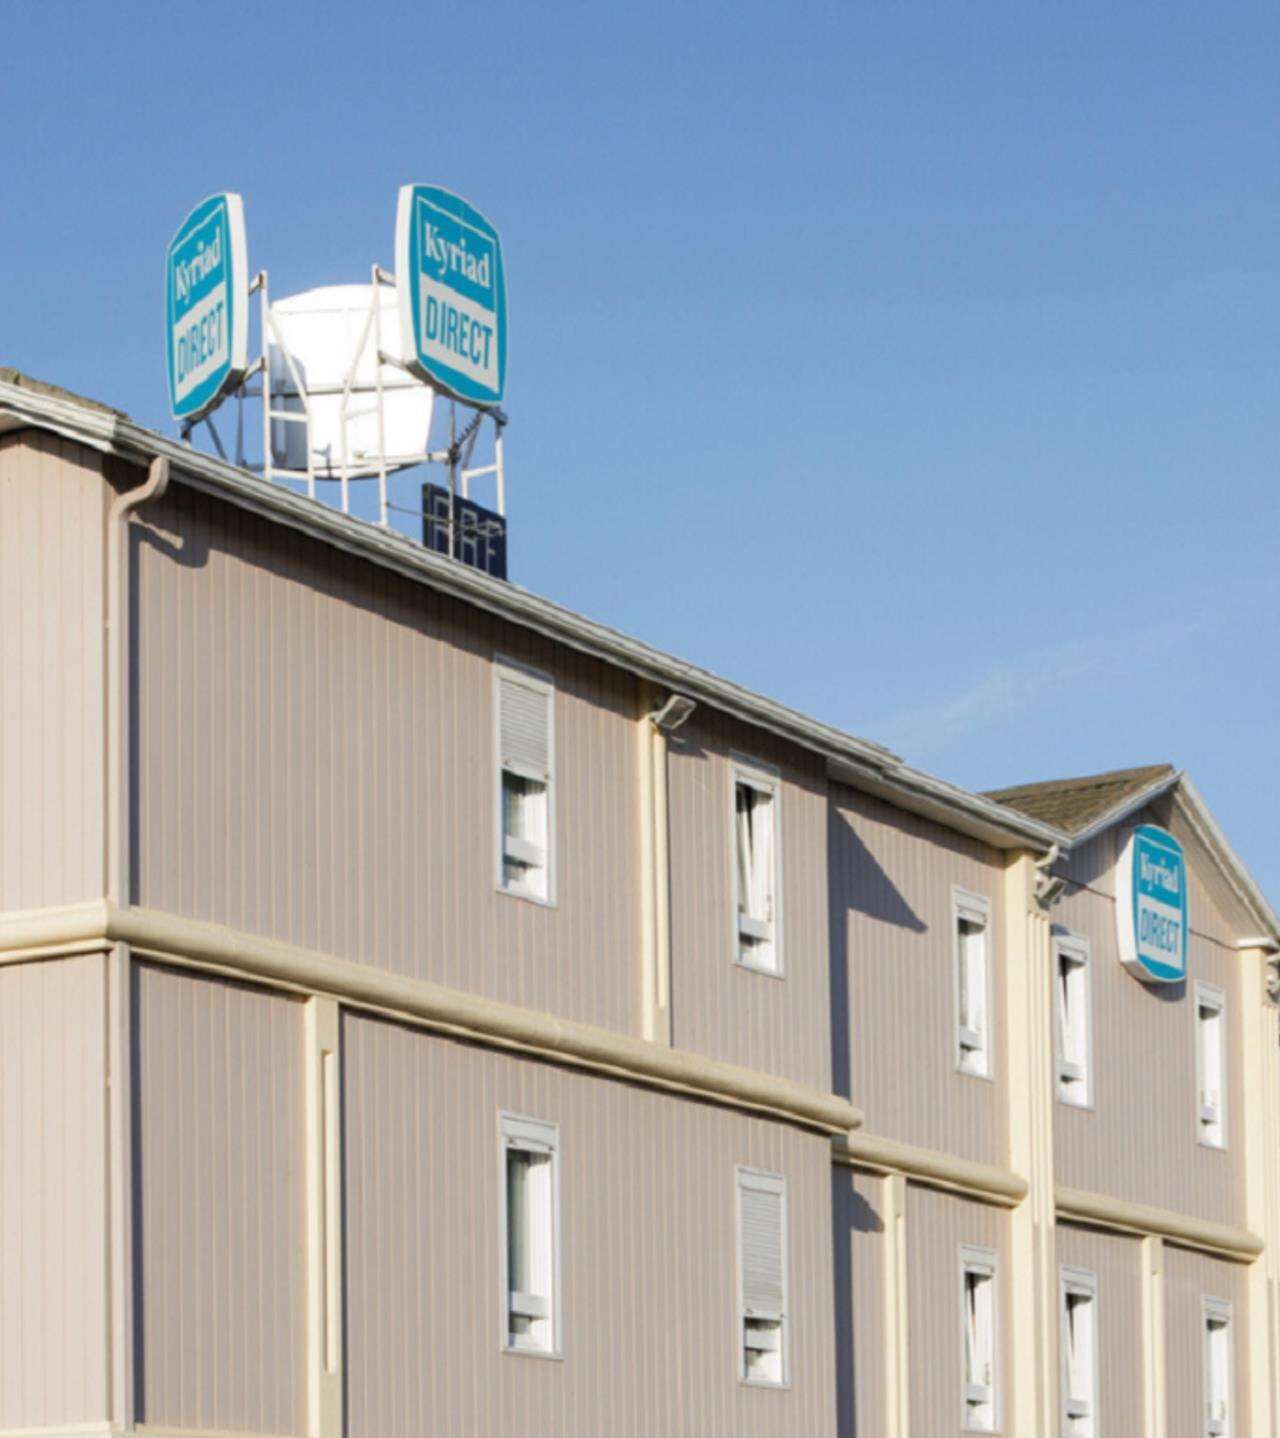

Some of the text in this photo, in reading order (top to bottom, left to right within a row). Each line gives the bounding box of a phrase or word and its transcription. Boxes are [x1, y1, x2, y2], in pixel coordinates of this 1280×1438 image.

[177, 226, 221, 304] Kyriad
[425, 222, 491, 289] Kyriad
[177, 301, 224, 384] DIRECT
[426, 296, 493, 370] DIRECT
[1140, 852, 1179, 894] Kyriad
[1141, 908, 1180, 956] DIRECT
